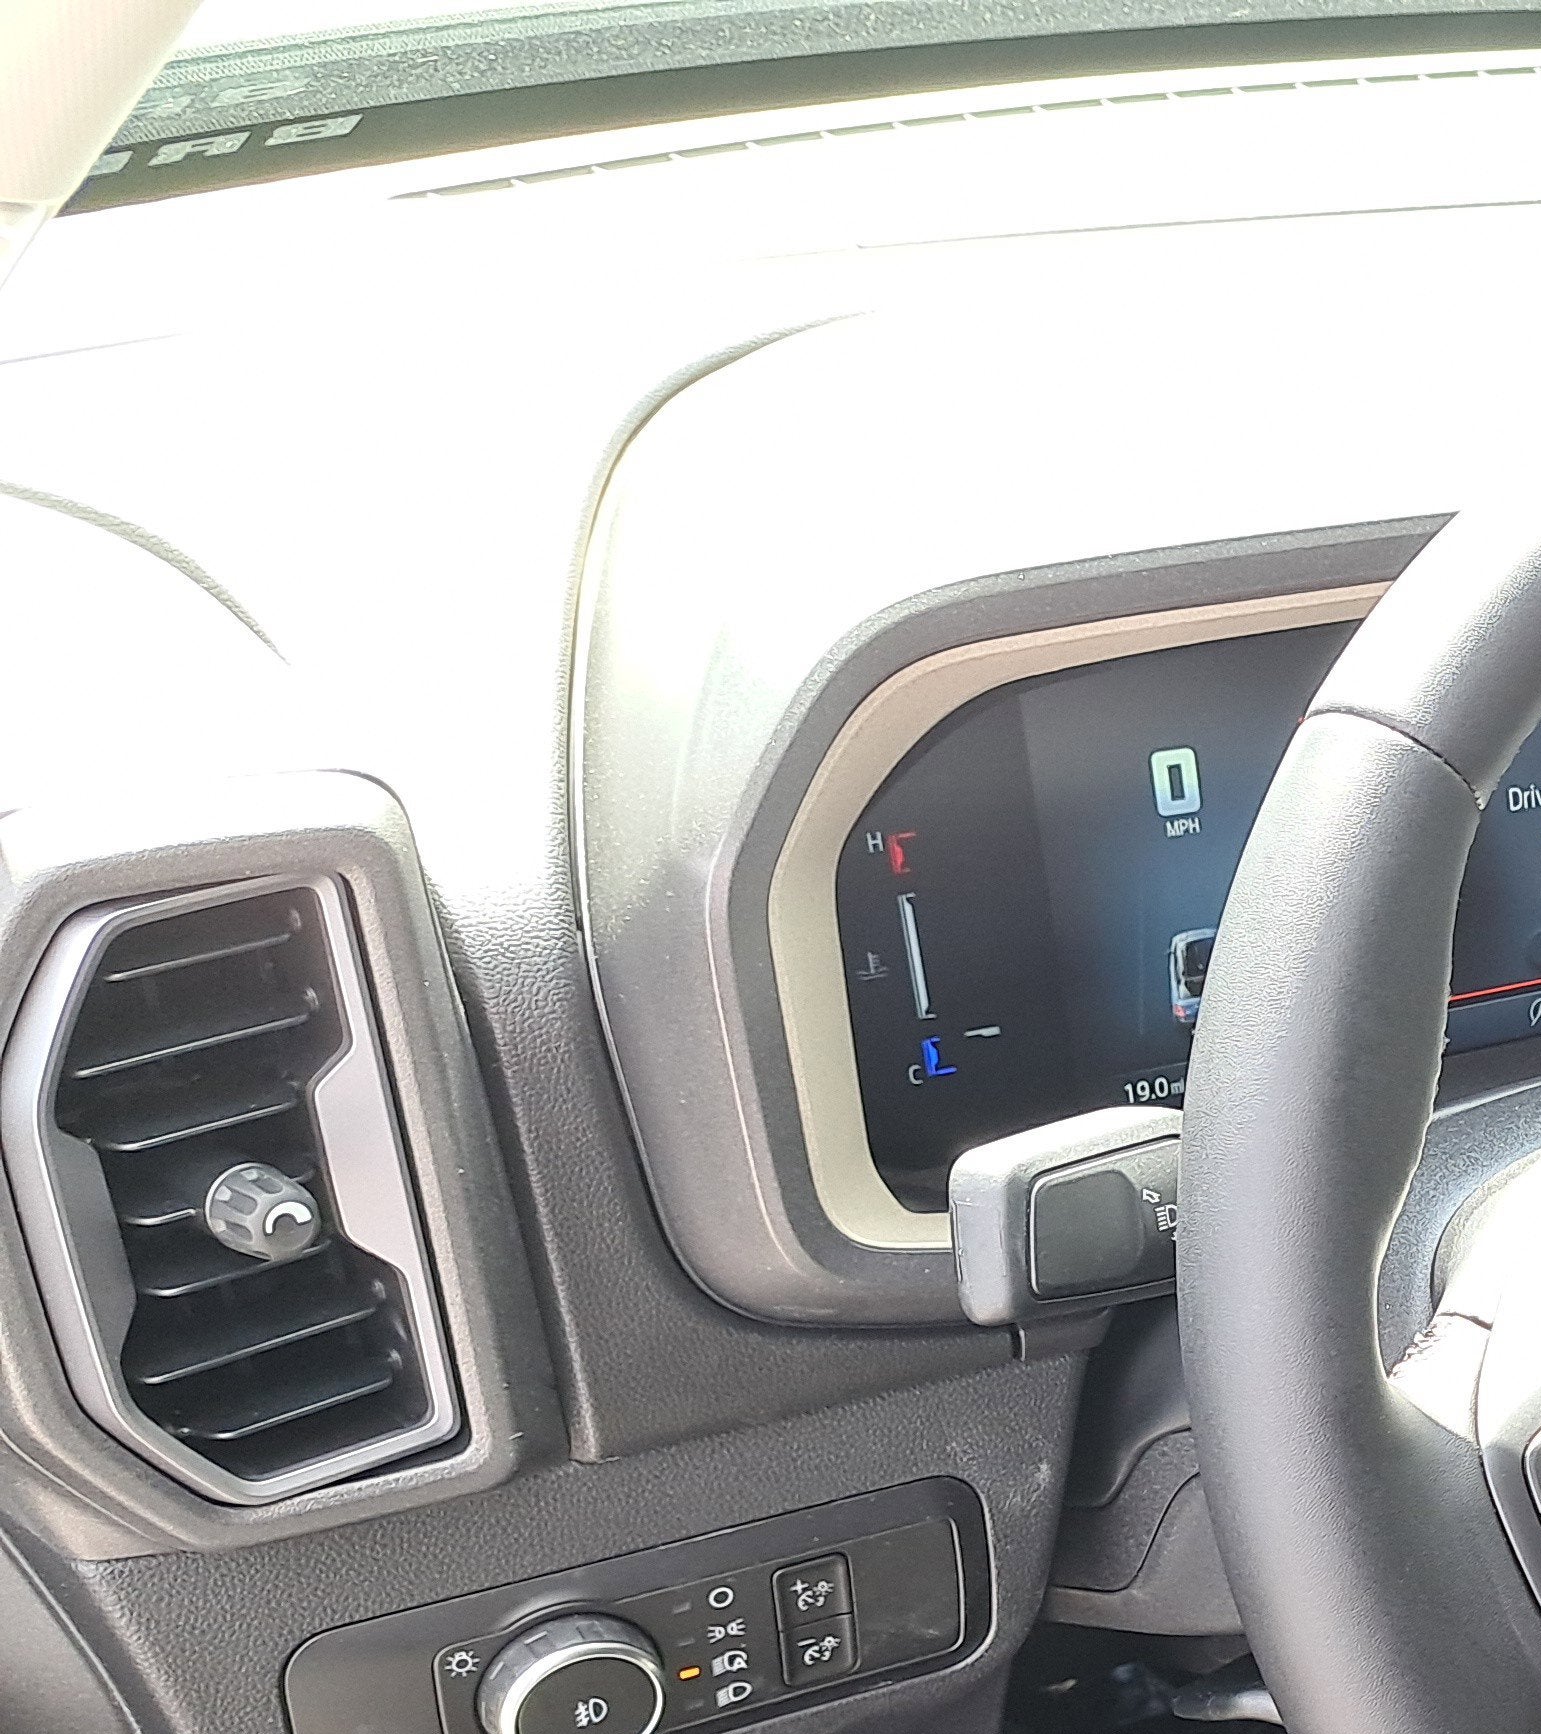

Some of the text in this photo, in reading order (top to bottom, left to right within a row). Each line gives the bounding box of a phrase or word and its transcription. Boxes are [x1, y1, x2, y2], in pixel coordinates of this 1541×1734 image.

[1149, 746, 1202, 818] 0
[1164, 816, 1201, 838] MPH
[866, 831, 884, 854] H
[908, 1064, 924, 1086] C
[1123, 1076, 1169, 1104] 19.0
